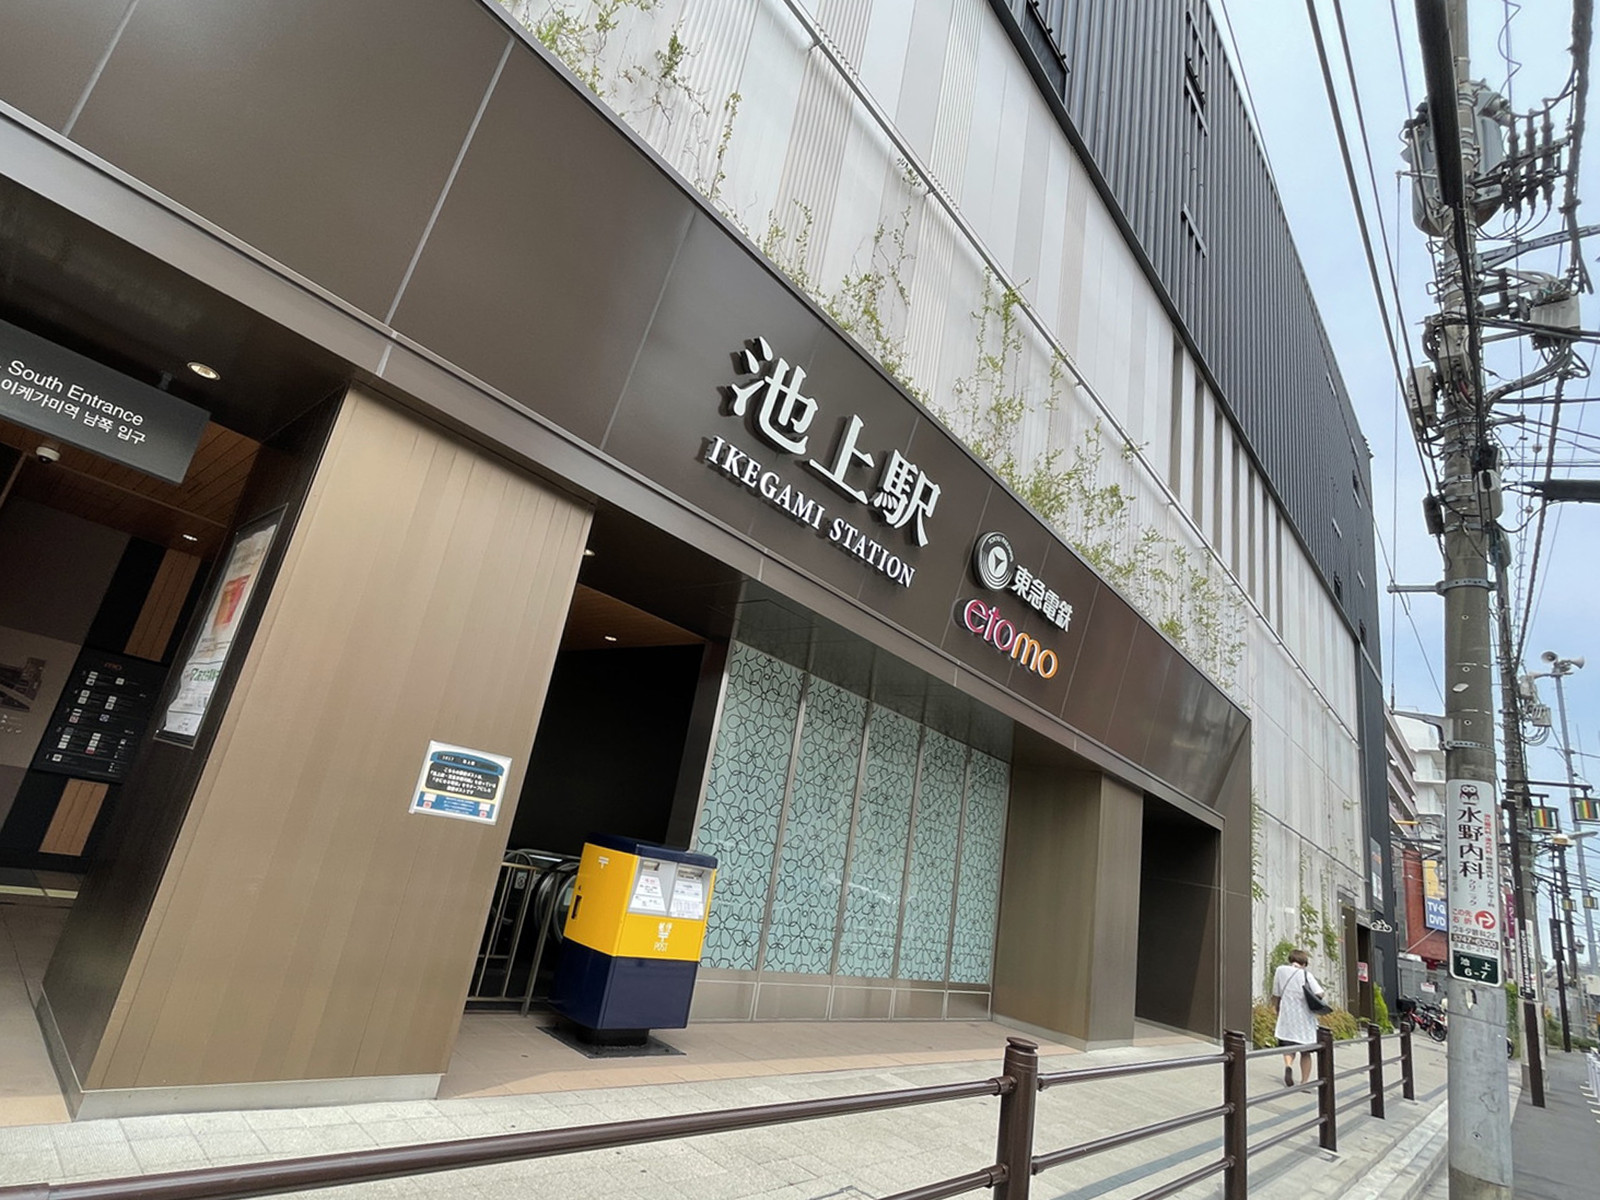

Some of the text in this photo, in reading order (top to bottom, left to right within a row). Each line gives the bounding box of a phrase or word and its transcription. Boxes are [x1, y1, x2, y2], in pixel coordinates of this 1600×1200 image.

[0, 378, 146, 445] 이케가미역 남쪽 입구
[8, 360, 144, 426] South Entrance
[731, 336, 942, 548] 池上駅
[706, 435, 916, 588] IKEGAMI STATION
[1011, 564, 1074, 632] 東急電鉄
[964, 599, 1059, 679] etomo
[1457, 806, 1485, 880] 水野内科
[1429, 914, 1446, 926] DVD
[1460, 957, 1492, 971] 池上
[1464, 967, 1488, 979] 6-7
